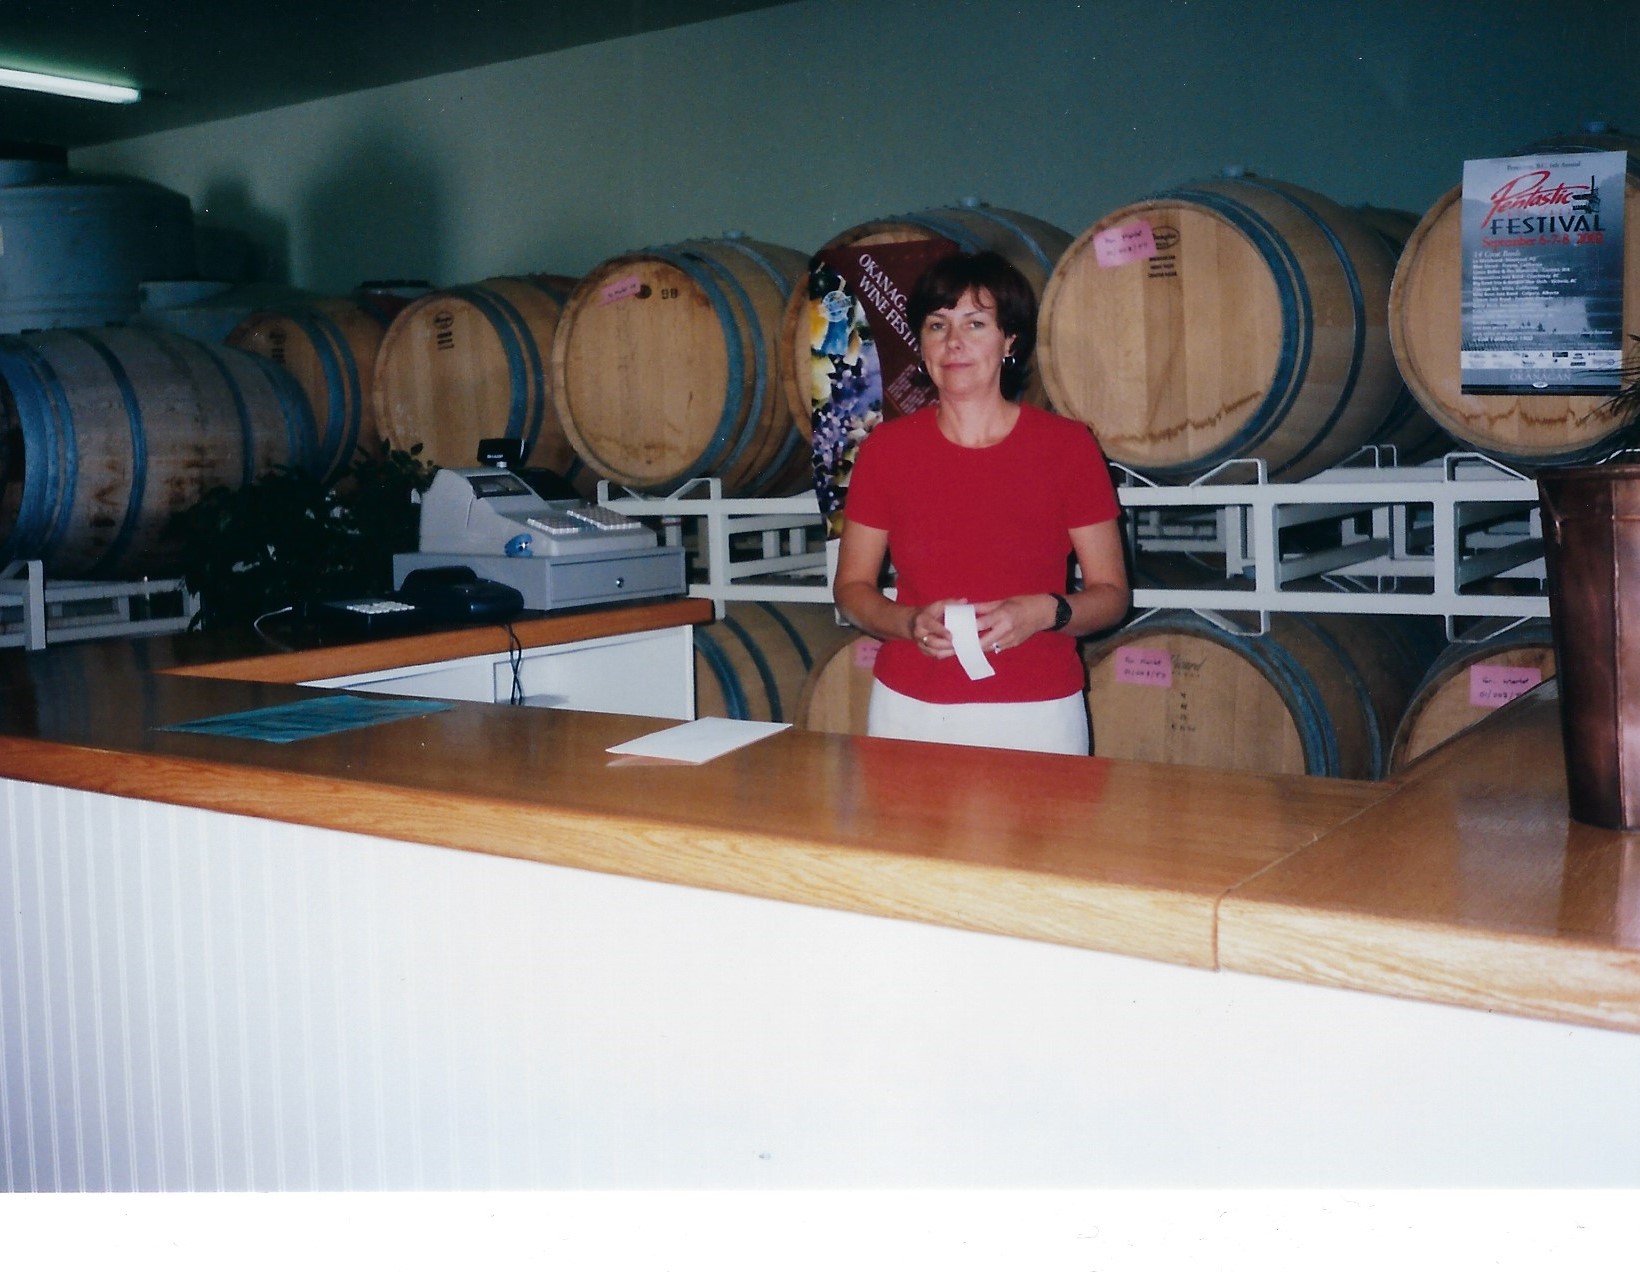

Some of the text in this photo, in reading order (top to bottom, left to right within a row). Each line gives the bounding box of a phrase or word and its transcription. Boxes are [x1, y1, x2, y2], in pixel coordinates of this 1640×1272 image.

[1481, 170, 1590, 229] Pentastic
[1482, 236, 1536, 250] September
[1490, 214, 1605, 235] FESTIVAL
[859, 254, 907, 317] OKANAG
[859, 275, 890, 314] WINE
[886, 308, 919, 351] FESTI
[1509, 373, 1571, 381] OKANAGAN
